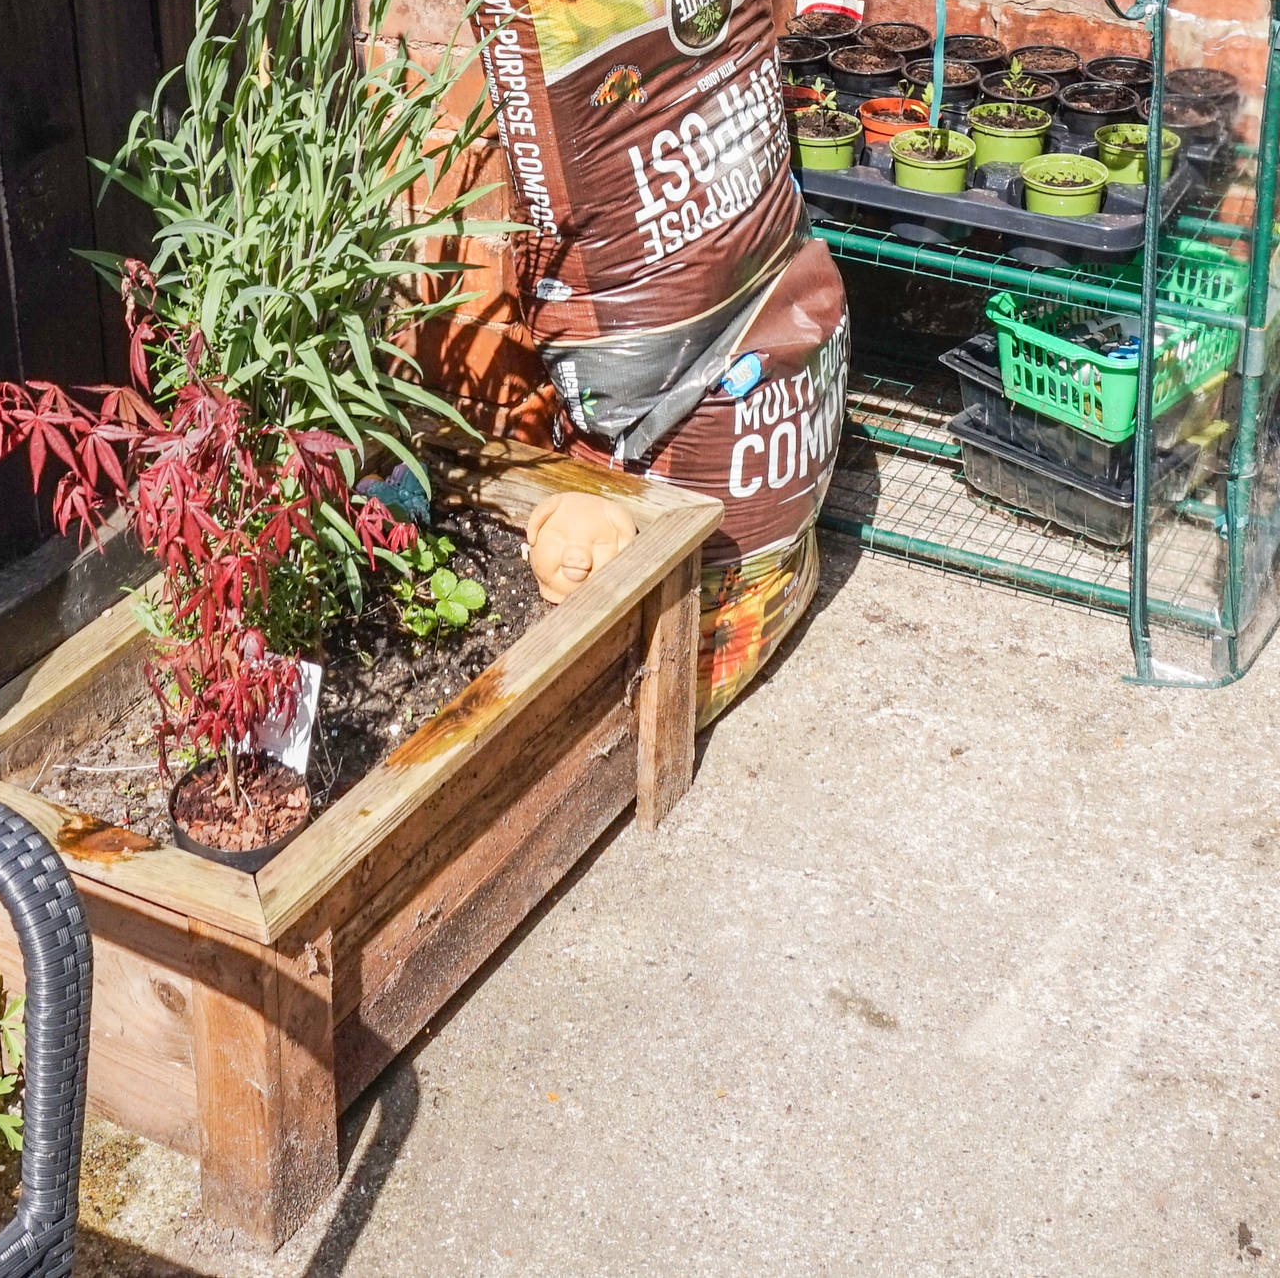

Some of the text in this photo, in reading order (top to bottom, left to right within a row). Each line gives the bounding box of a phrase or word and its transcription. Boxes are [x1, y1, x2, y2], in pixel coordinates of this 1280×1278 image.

[697, 69, 720, 92] ADDED
[561, 361, 590, 434] RICHMOO
[729, 361, 848, 498] COMPO
